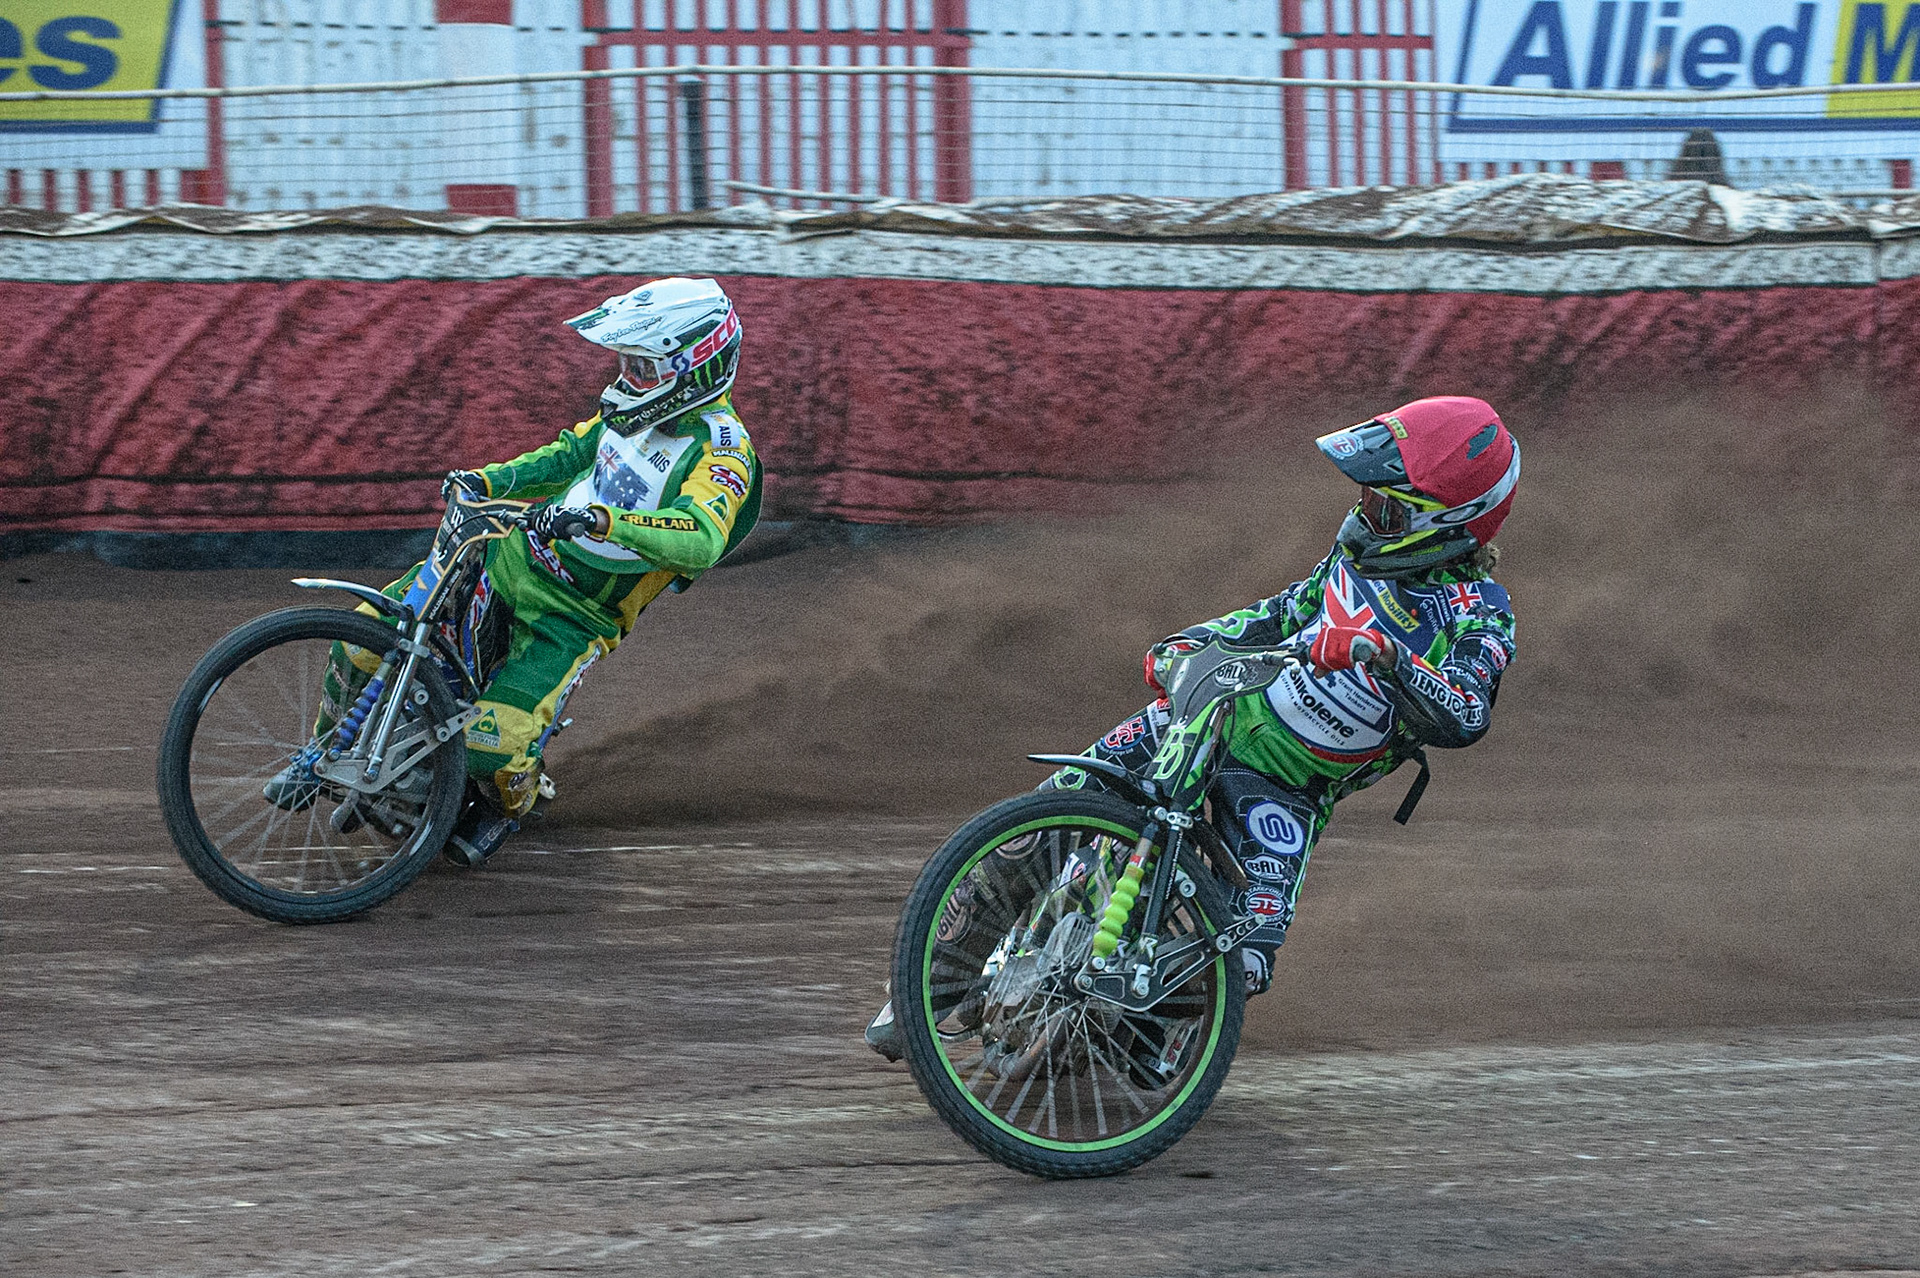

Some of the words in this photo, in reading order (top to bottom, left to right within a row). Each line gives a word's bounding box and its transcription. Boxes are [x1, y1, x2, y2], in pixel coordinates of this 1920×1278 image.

[1489, 0, 1816, 90] Allied
[719, 426, 731, 446] AUS
[647, 451, 670, 473] AUS
[652, 517, 695, 530] PLANT
[1382, 592, 1415, 629] Mobility
[1338, 679, 1353, 693] Grant
[1353, 690, 1382, 712] Henderson
[1280, 674, 1295, 700] SUPERIOR
[1293, 701, 1329, 735] MOTORCYCLE
[1330, 734, 1345, 746] OILS
[1245, 886, 1283, 898] STAKEFORD
[1248, 897, 1282, 910] STS
